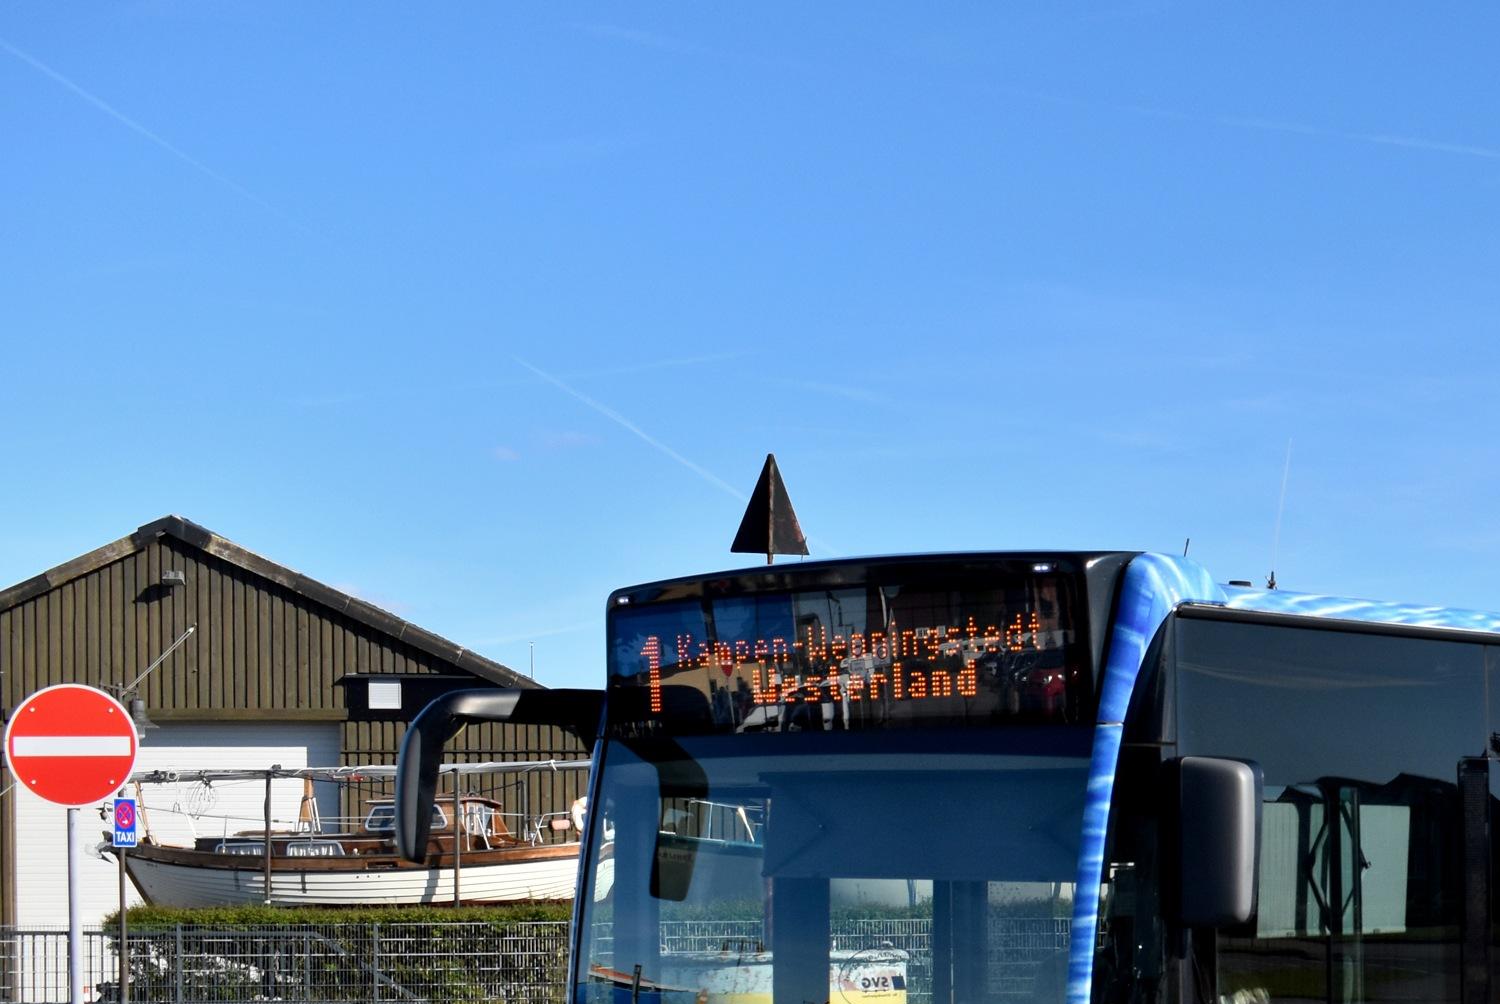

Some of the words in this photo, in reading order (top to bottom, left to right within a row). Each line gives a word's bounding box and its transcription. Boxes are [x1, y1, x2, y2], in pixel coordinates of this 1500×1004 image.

[640, 635, 661, 713] 1
[752, 659, 977, 705] Westerland
[116, 831, 135, 843] TAXI
